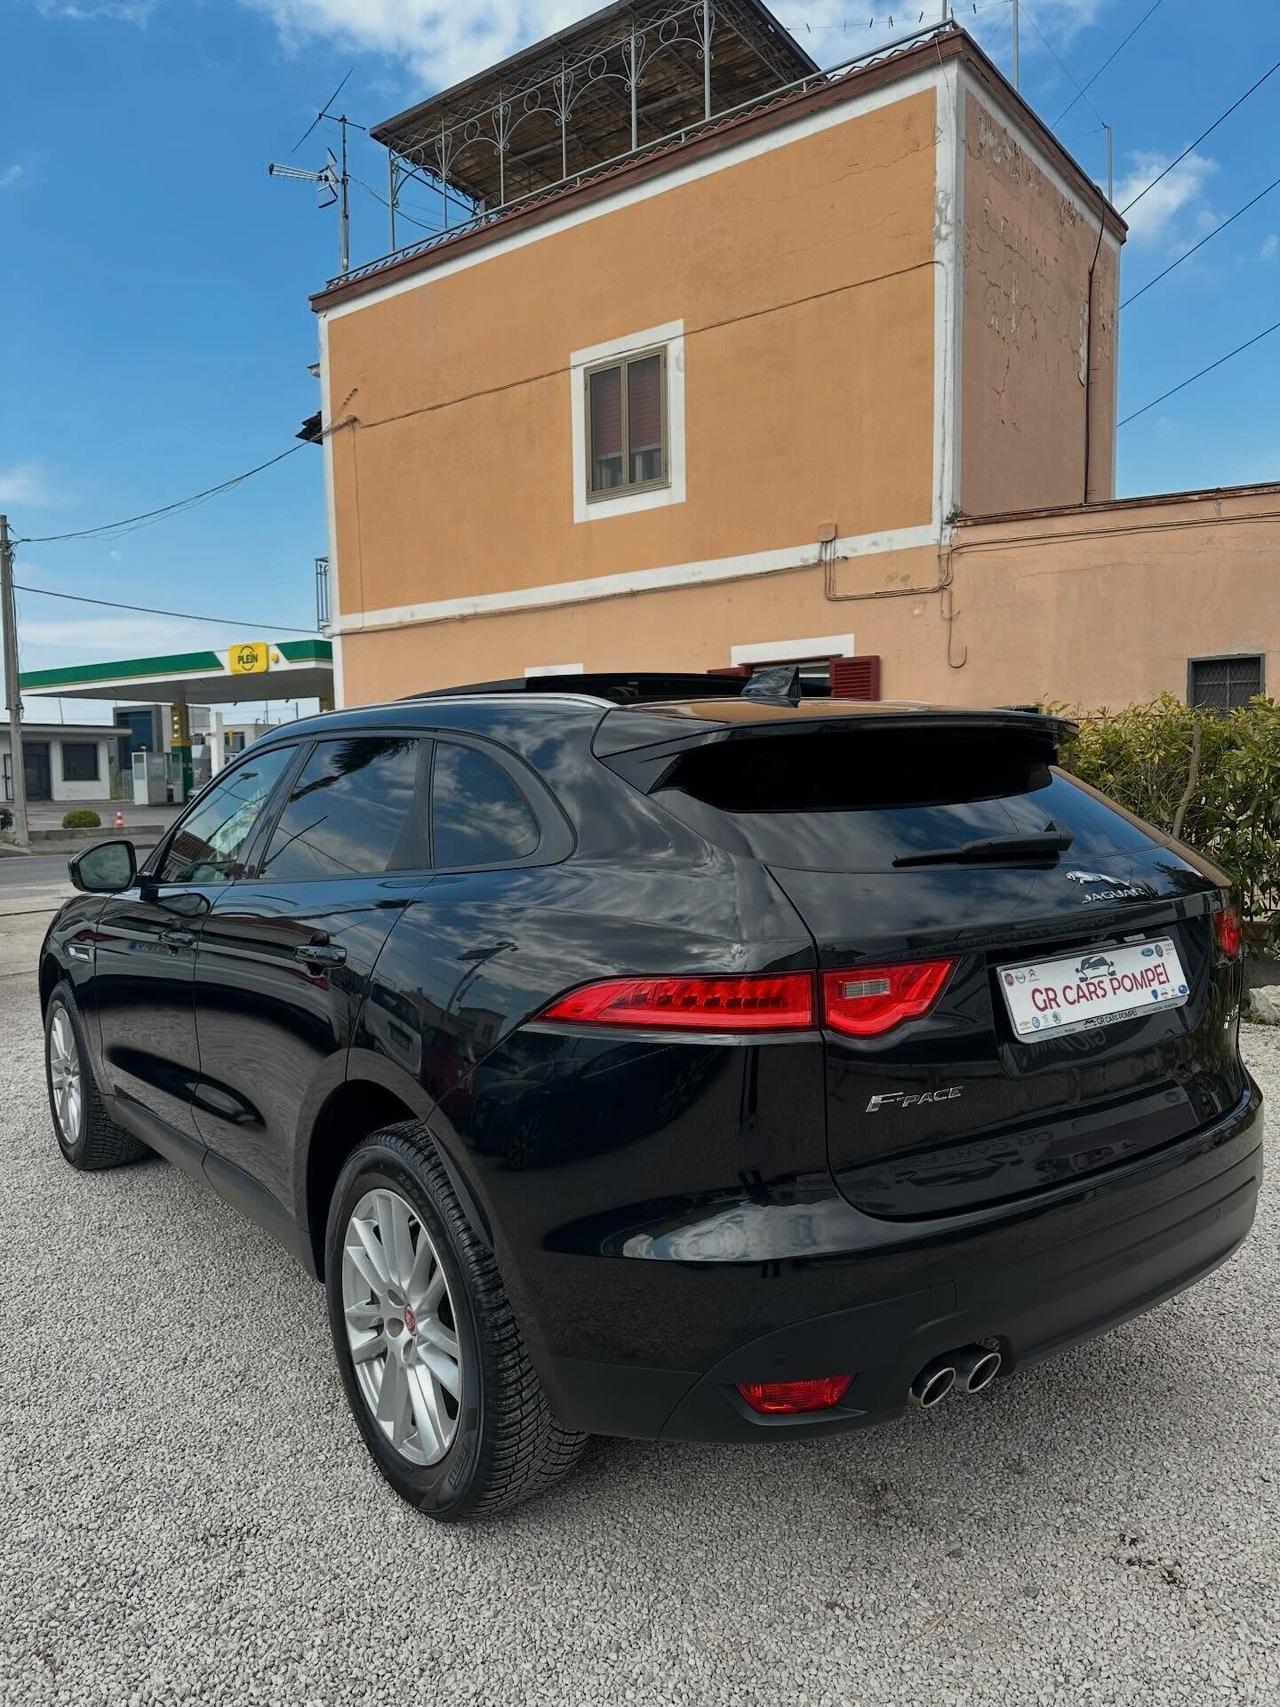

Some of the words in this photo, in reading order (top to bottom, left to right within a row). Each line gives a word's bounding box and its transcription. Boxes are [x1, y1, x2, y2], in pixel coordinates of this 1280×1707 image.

[1082, 887, 1145, 904] JAGUAR
[1032, 987, 1060, 1012] GR
[1063, 980, 1107, 1006] CARS
[1109, 963, 1170, 995] POMPEI
[866, 1086, 964, 1113] F-PACE
